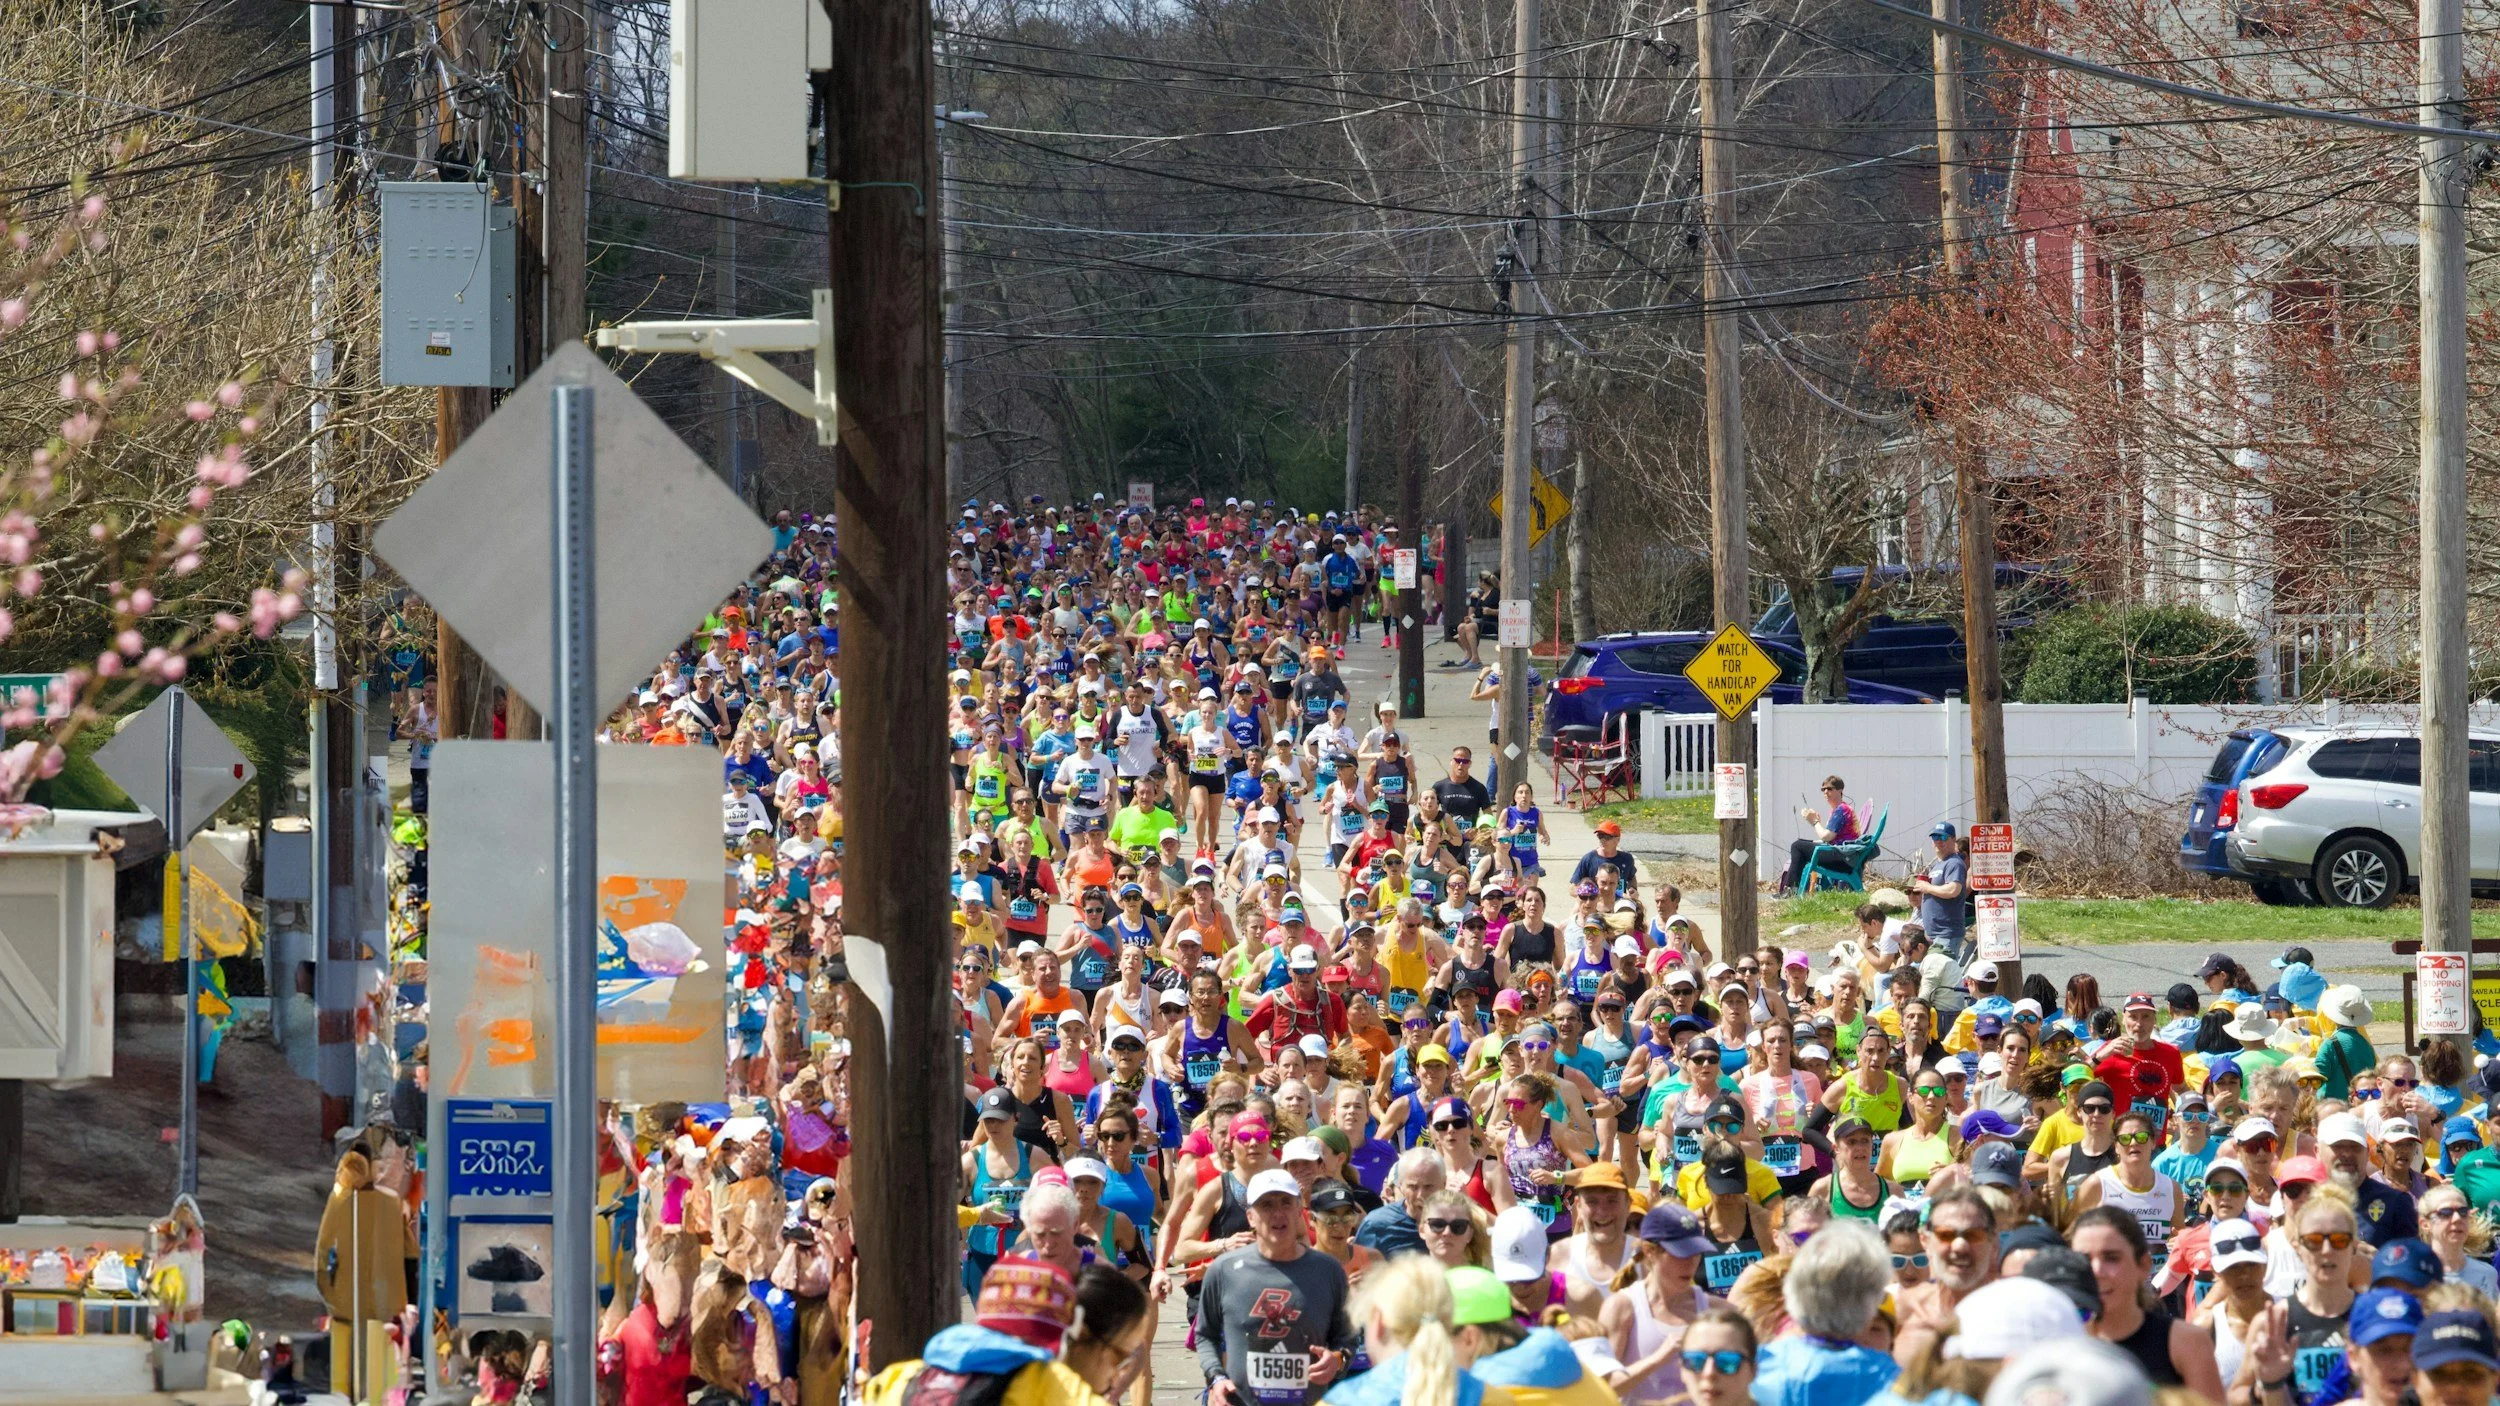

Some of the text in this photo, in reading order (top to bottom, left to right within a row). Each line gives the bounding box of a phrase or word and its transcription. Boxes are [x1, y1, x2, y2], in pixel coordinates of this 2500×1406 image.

[1508, 606, 1521, 615] NO
[1501, 617, 1528, 626] PARKING
[1716, 643, 1748, 656] WATCH
[1722, 660, 1741, 672] FOR
[1707, 676, 1757, 689] HANDICAP
[1723, 693, 1742, 706] VAN
[1979, 826, 2005, 836] SNOW
[1972, 842, 2013, 851] ARTERY
[1973, 876, 2012, 886] TOW ZONE
[1012, 902, 1034, 913] 19257
[1989, 909, 2002, 917] NO
[1980, 916, 2013, 924] STOPPING
[1984, 949, 2011, 958] MONDAY
[2433, 970, 2449, 979] NO
[2423, 980, 2462, 988] STOPPING
[2425, 1020, 2458, 1029] MONDAY
[1677, 1138, 1701, 1155] 200
[1253, 1356, 1304, 1380] 15596
